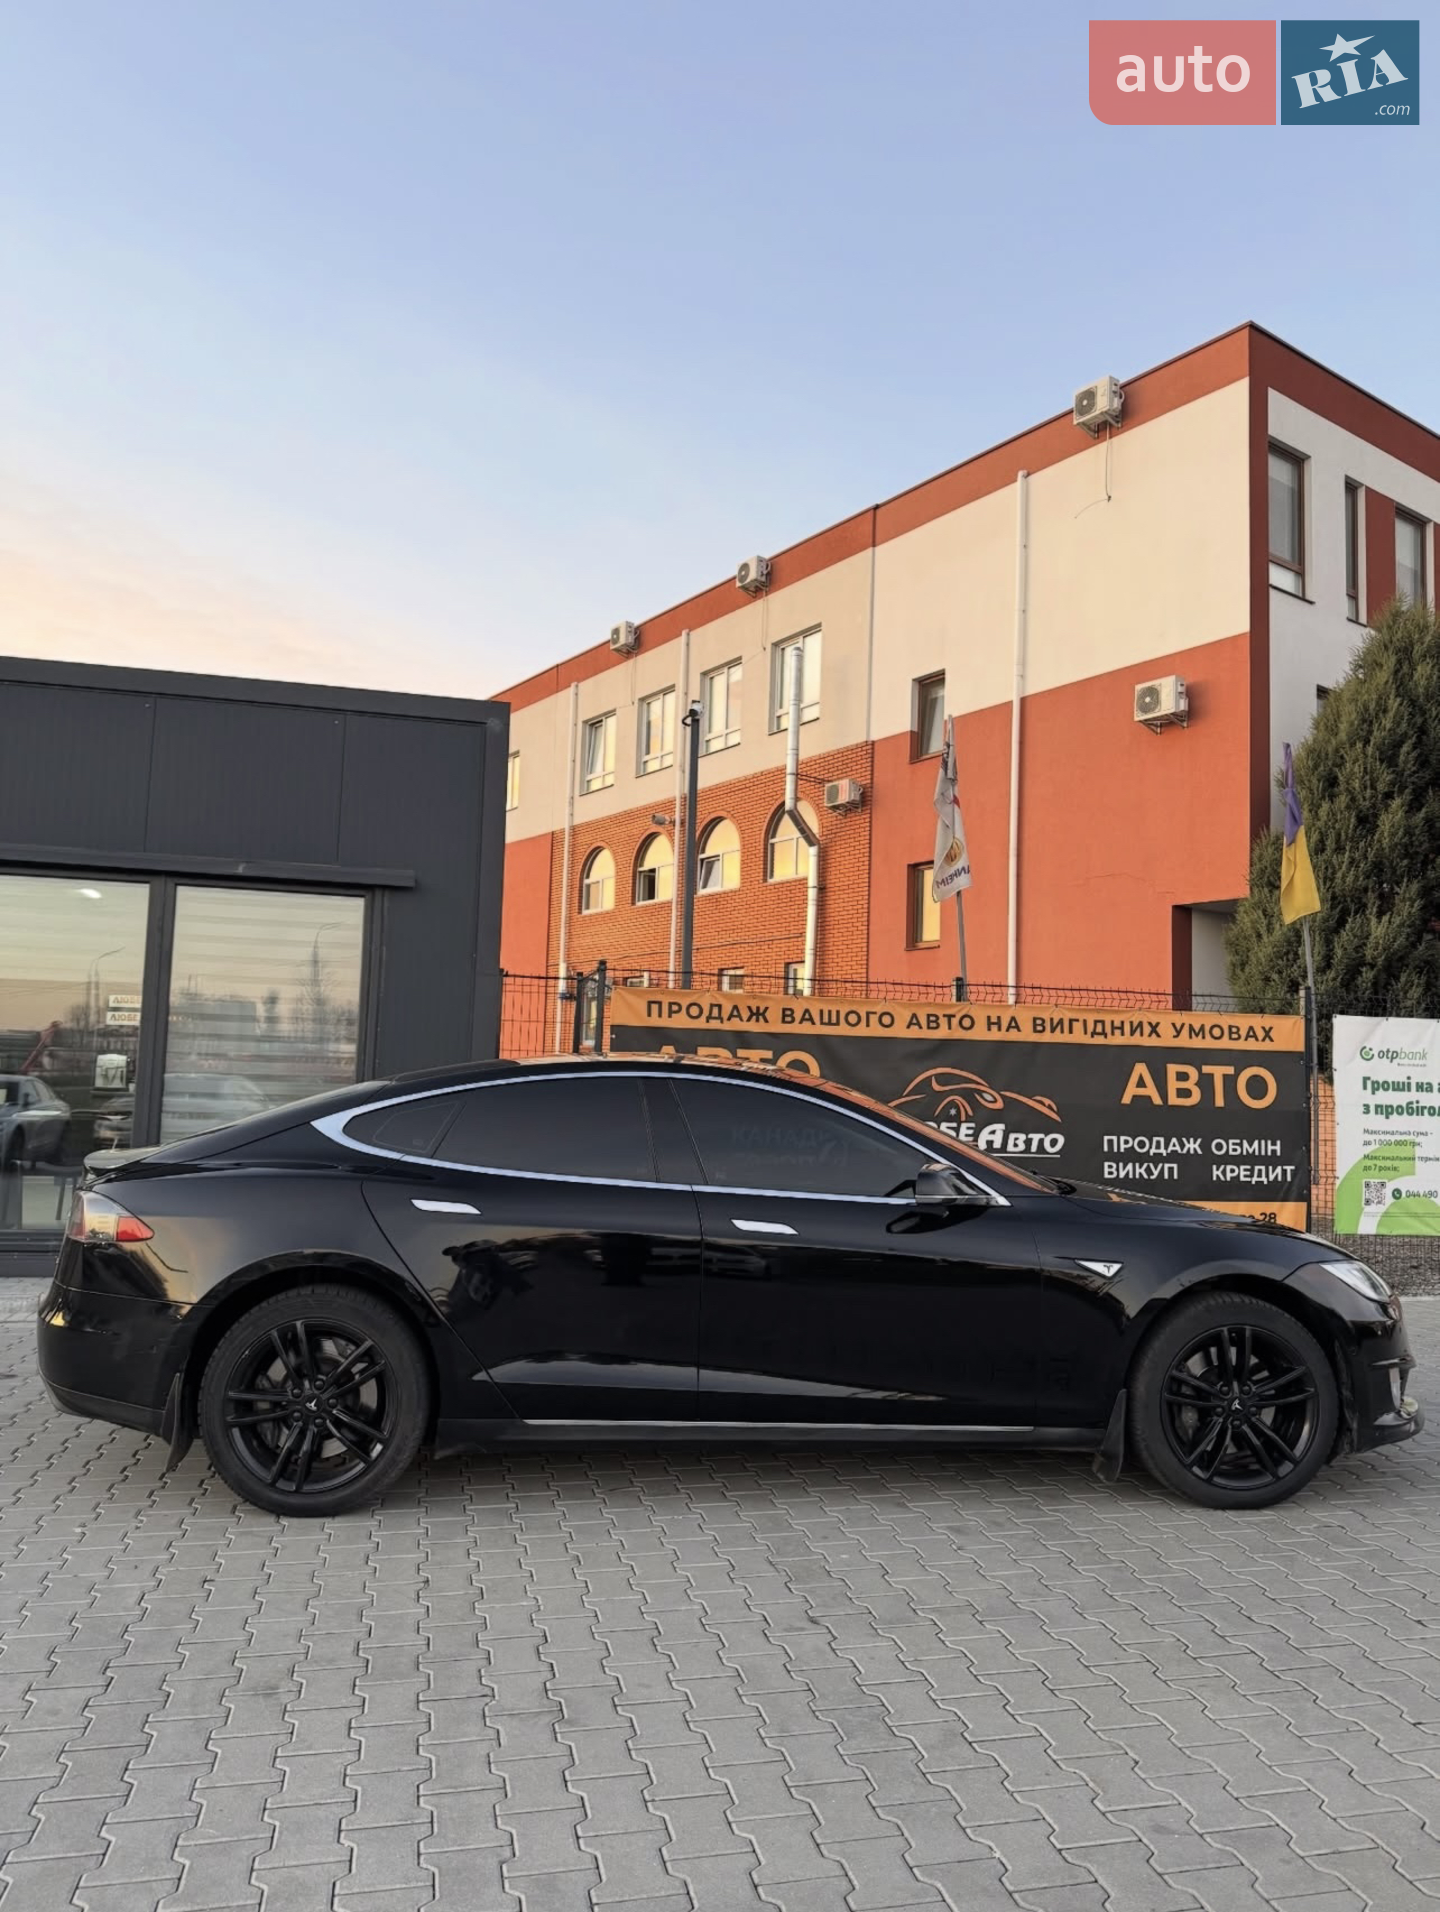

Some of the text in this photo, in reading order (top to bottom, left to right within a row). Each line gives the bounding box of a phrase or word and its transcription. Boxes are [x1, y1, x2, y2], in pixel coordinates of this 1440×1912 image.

[646, 1000, 1275, 1043] ПРОДАЖ ВАШОГО АВТО НА ВИГІДНИХ УМОВАХ
[1120, 1062, 1278, 1109] АВТО
[1362, 1075, 1412, 1095] Гроші
[1415, 1081, 1434, 1093] на
[1362, 1103, 1371, 1115] з
[1103, 1135, 1281, 1157] ПРОДАЖ ОБМІН
[1103, 1162, 1296, 1185] ВИКУП КРЕДИТ
[1405, 1190, 1439, 1199] 044 490
